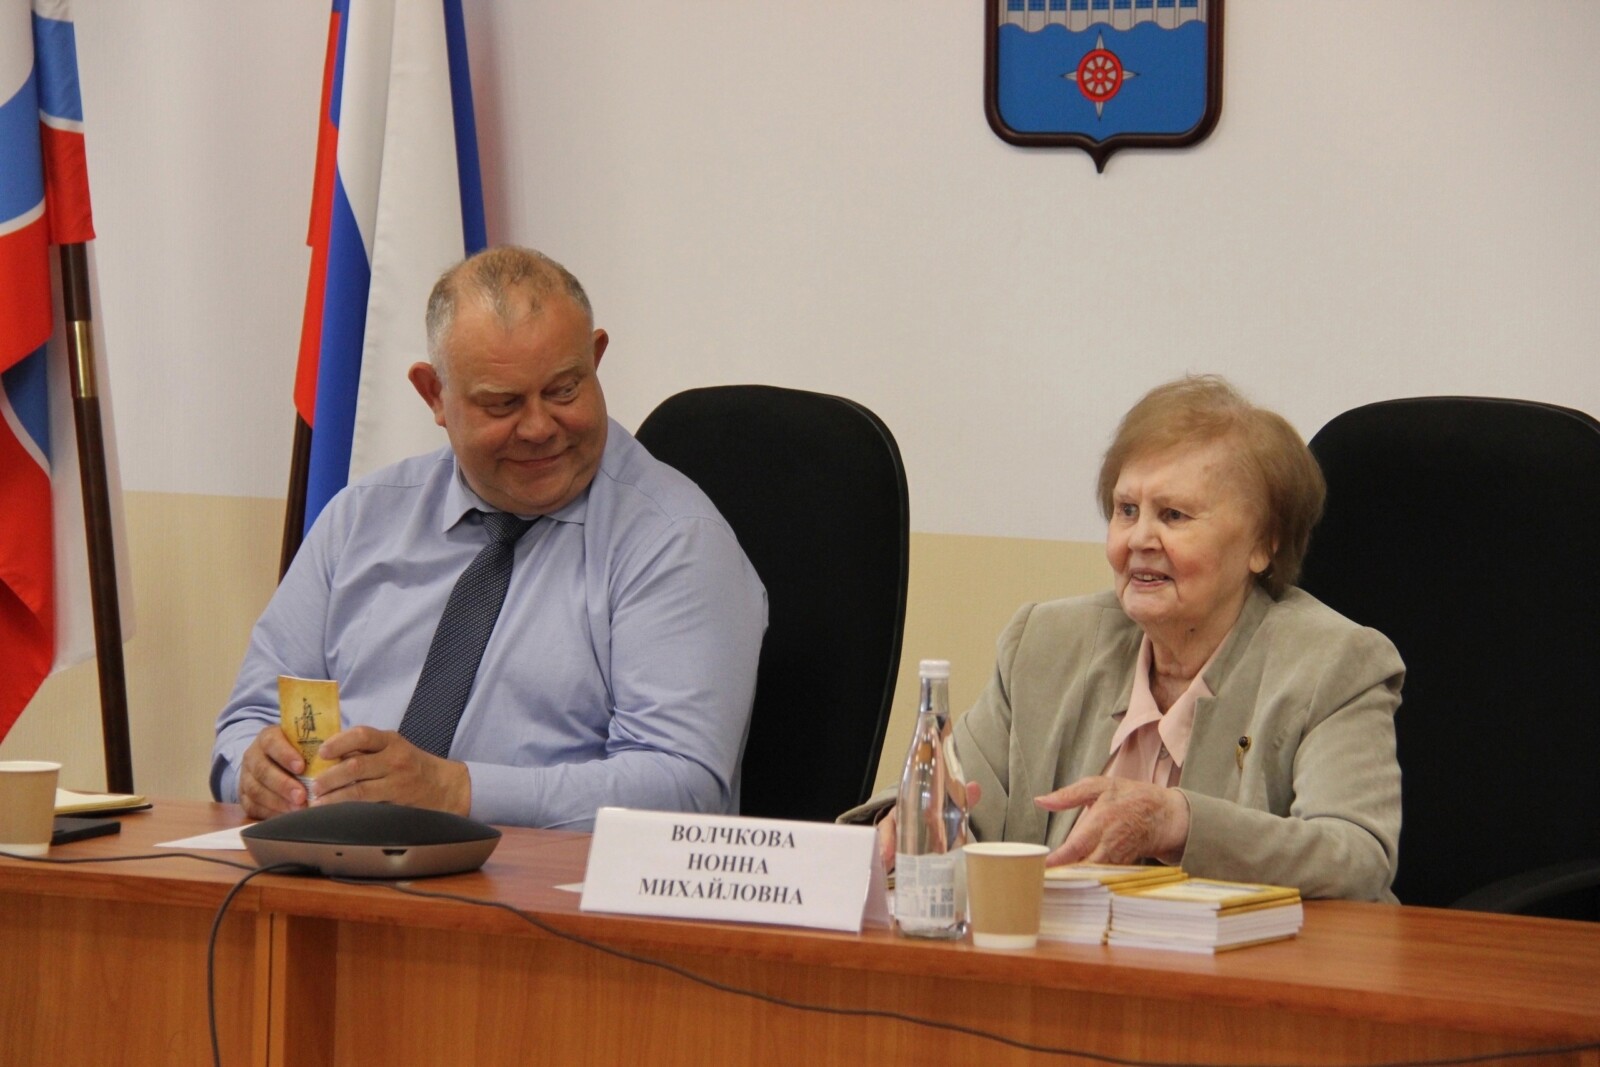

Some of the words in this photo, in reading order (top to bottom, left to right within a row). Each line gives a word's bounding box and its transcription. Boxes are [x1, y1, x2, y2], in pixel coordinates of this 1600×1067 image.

[671, 824, 796, 848] ВОЛЧКОВА
[687, 853, 769, 874] НОННА
[639, 878, 804, 905] МИХАЙЛОВНА
